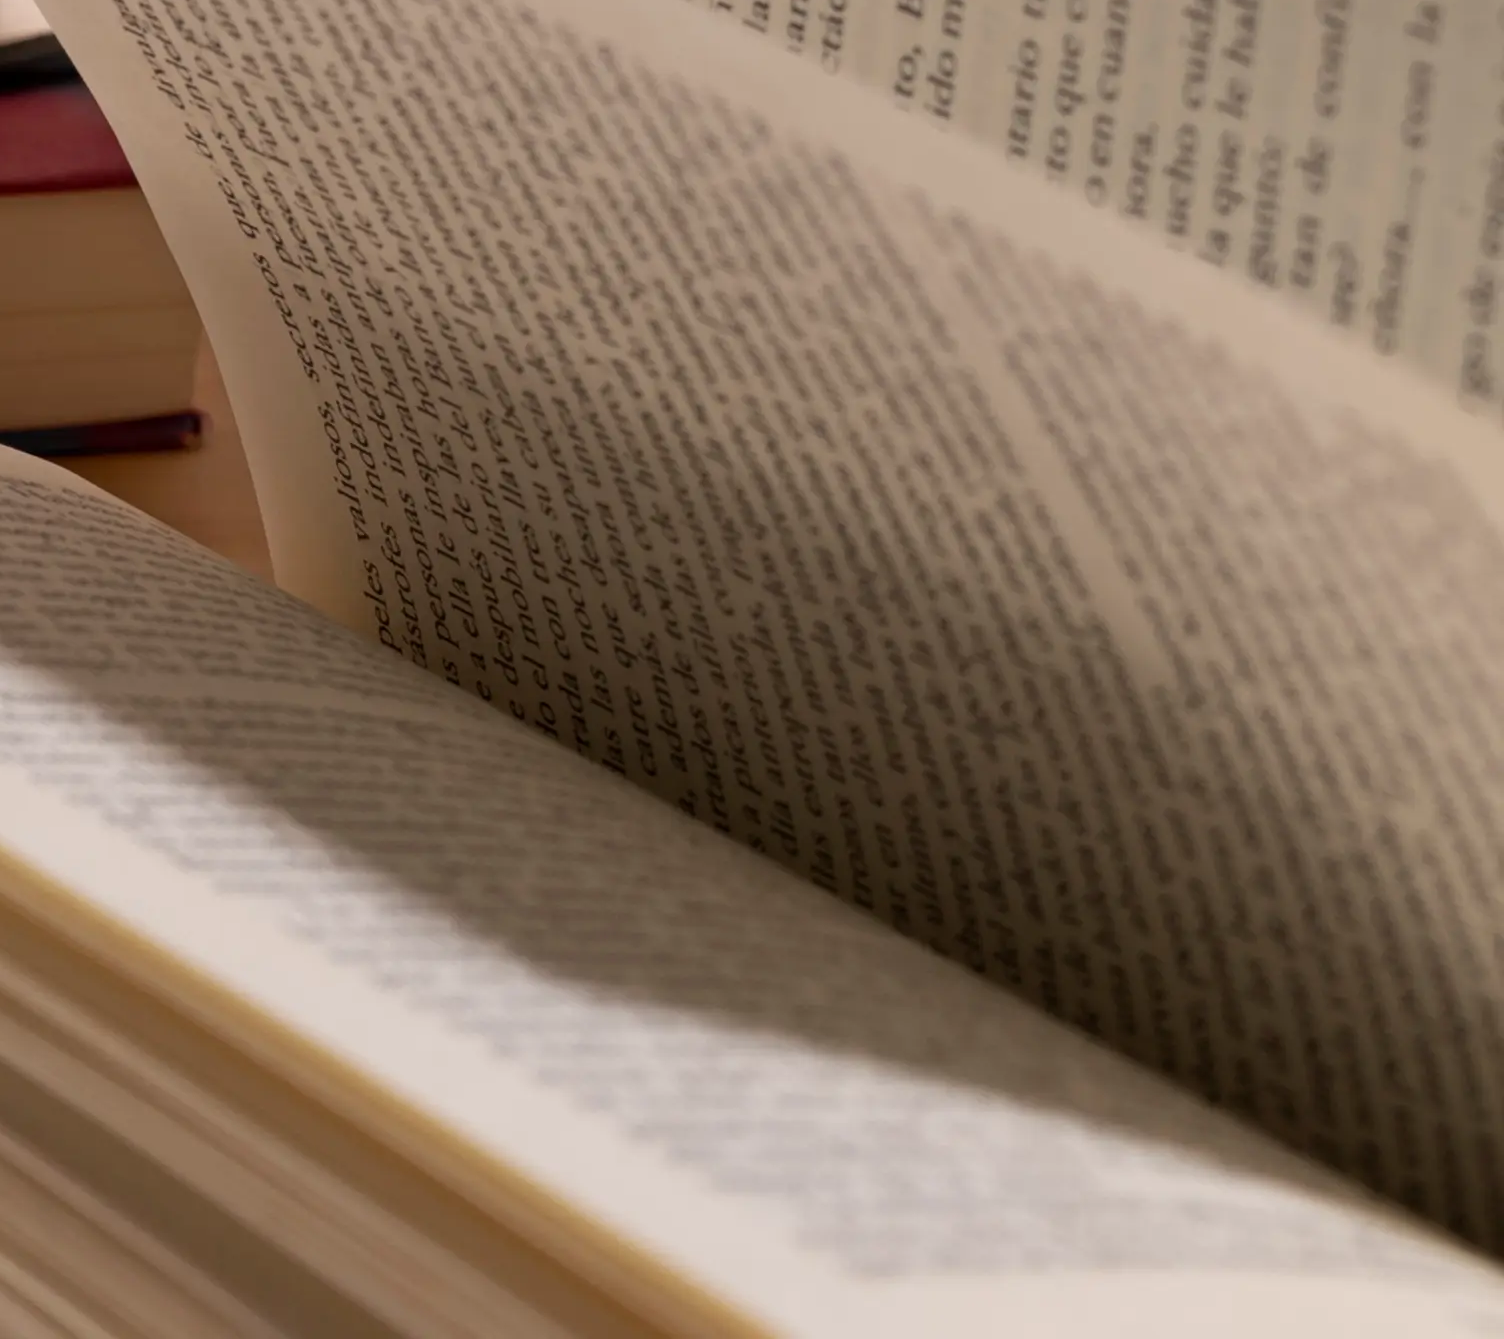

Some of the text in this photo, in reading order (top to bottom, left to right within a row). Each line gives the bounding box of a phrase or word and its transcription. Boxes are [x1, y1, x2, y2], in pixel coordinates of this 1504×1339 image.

[193, 55, 221, 90] lo
[1054, 33, 1088, 117] que
[184, 122, 214, 161] de
[1090, 112, 1116, 168] en
[211, 127, 304, 274] personas
[217, 175, 258, 240] que,
[262, 170, 328, 280] fuesen,
[292, 282, 313, 303] a
[294, 183, 377, 334] antipatía.
[365, 277, 394, 318] de
[253, 251, 320, 383] secretos
[393, 285, 455, 392] Banco
[308, 315, 389, 508] indefinidas
[320, 287, 407, 478] indefinidas
[390, 328, 440, 422] horas
[371, 341, 450, 524] inspiraban
[434, 434, 463, 483] las
[439, 395, 479, 454] del
[476, 409, 527, 511] llaves,
[317, 400, 371, 544] valiosos,
[451, 492, 479, 536] de
[533, 480, 559, 522] su
[398, 488, 461, 650] personas
[436, 531, 462, 567] le
[470, 462, 541, 649] mobiliario
[518, 519, 550, 585] tres
[363, 558, 403, 655] peles
[380, 521, 428, 669] tástrofes
[448, 575, 481, 639] ella
[469, 545, 520, 688] después
[542, 594, 572, 662] con
[550, 528, 600, 656] noches
[522, 653, 550, 691] el
[600, 601, 637, 670] que
[590, 664, 615, 716] las
